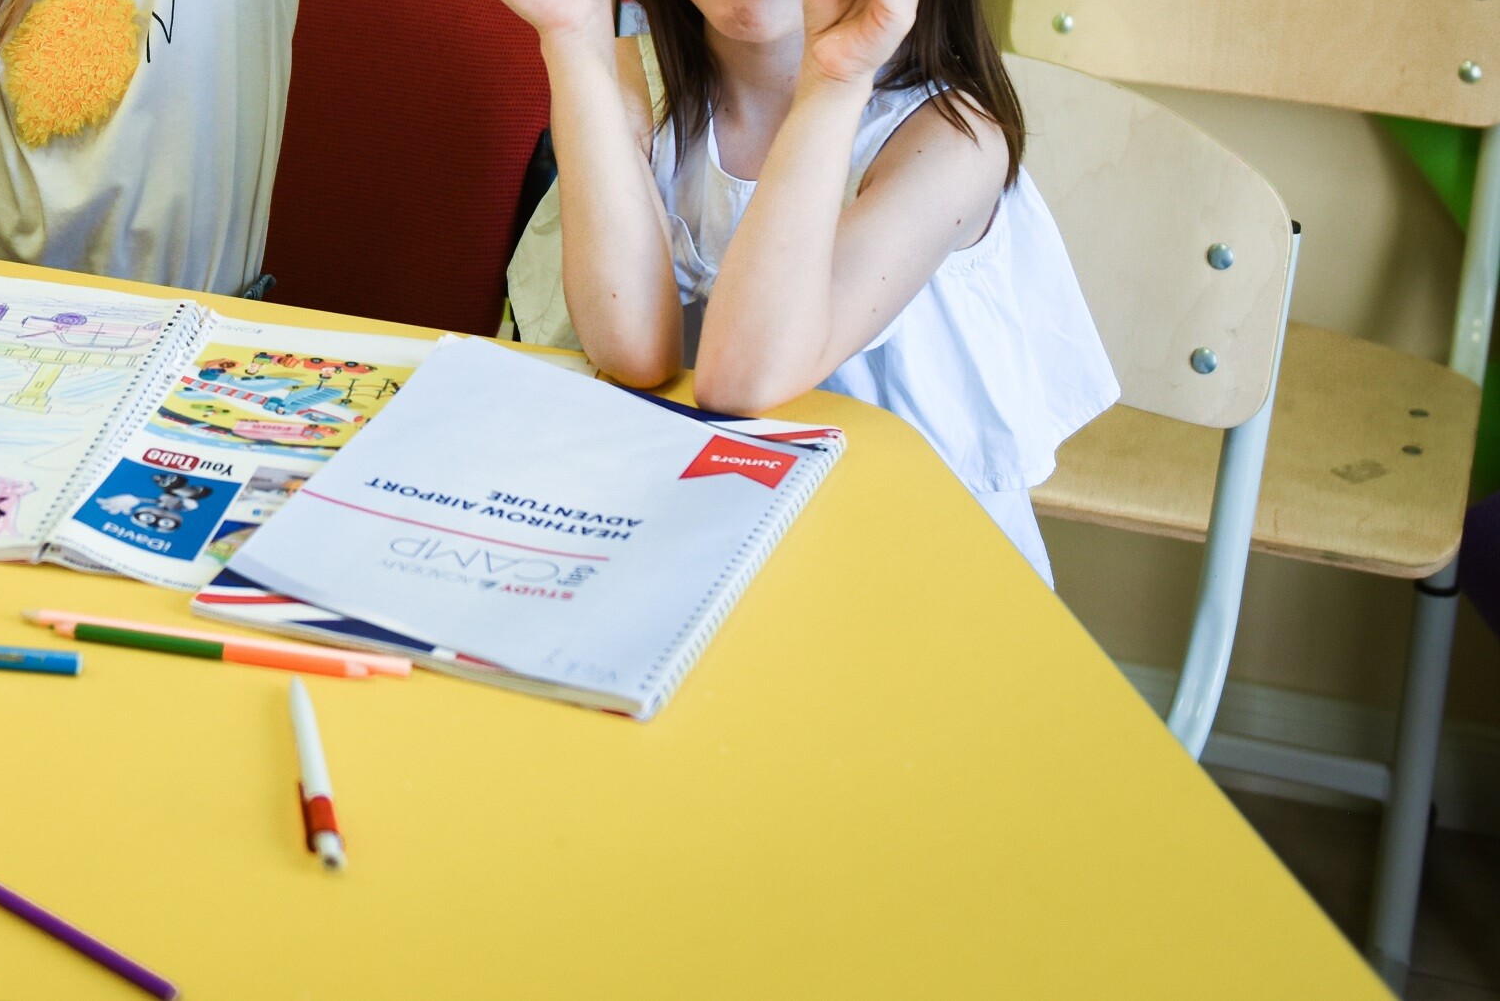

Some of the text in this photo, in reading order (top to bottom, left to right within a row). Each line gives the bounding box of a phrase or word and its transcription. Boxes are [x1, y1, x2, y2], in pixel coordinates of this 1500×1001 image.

[709, 453, 783, 470] Juniors
[365, 477, 632, 541] HEATHROW AIRPORT
[486, 489, 644, 529] ADVENTURE
[101, 520, 173, 553] iDavid
[389, 536, 561, 582] CAMP
[501, 583, 575, 601] STUDY
